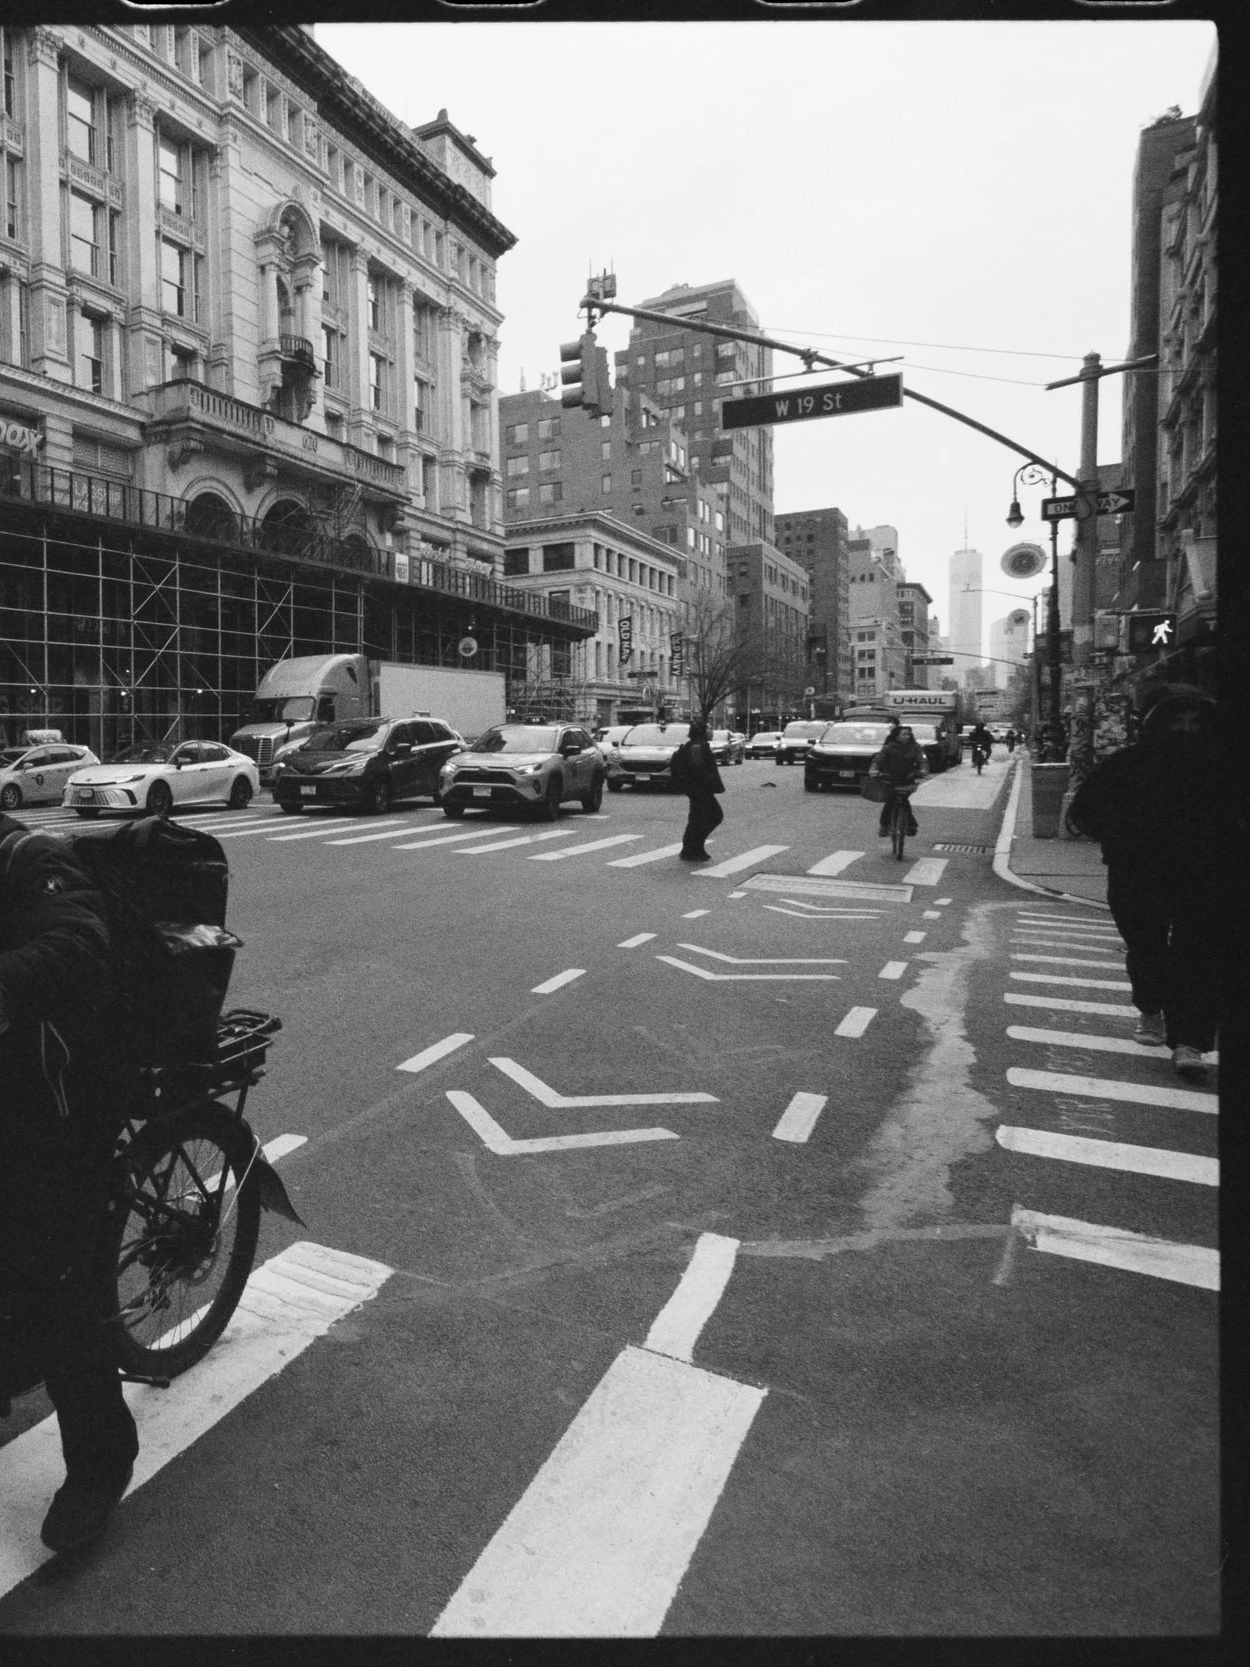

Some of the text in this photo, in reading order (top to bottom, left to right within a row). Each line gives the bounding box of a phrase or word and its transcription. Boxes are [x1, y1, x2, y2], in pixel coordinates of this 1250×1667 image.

[775, 392, 843, 417] W 19 St
[620, 621, 630, 640] OLD
[893, 697, 946, 705] U-HAUL
